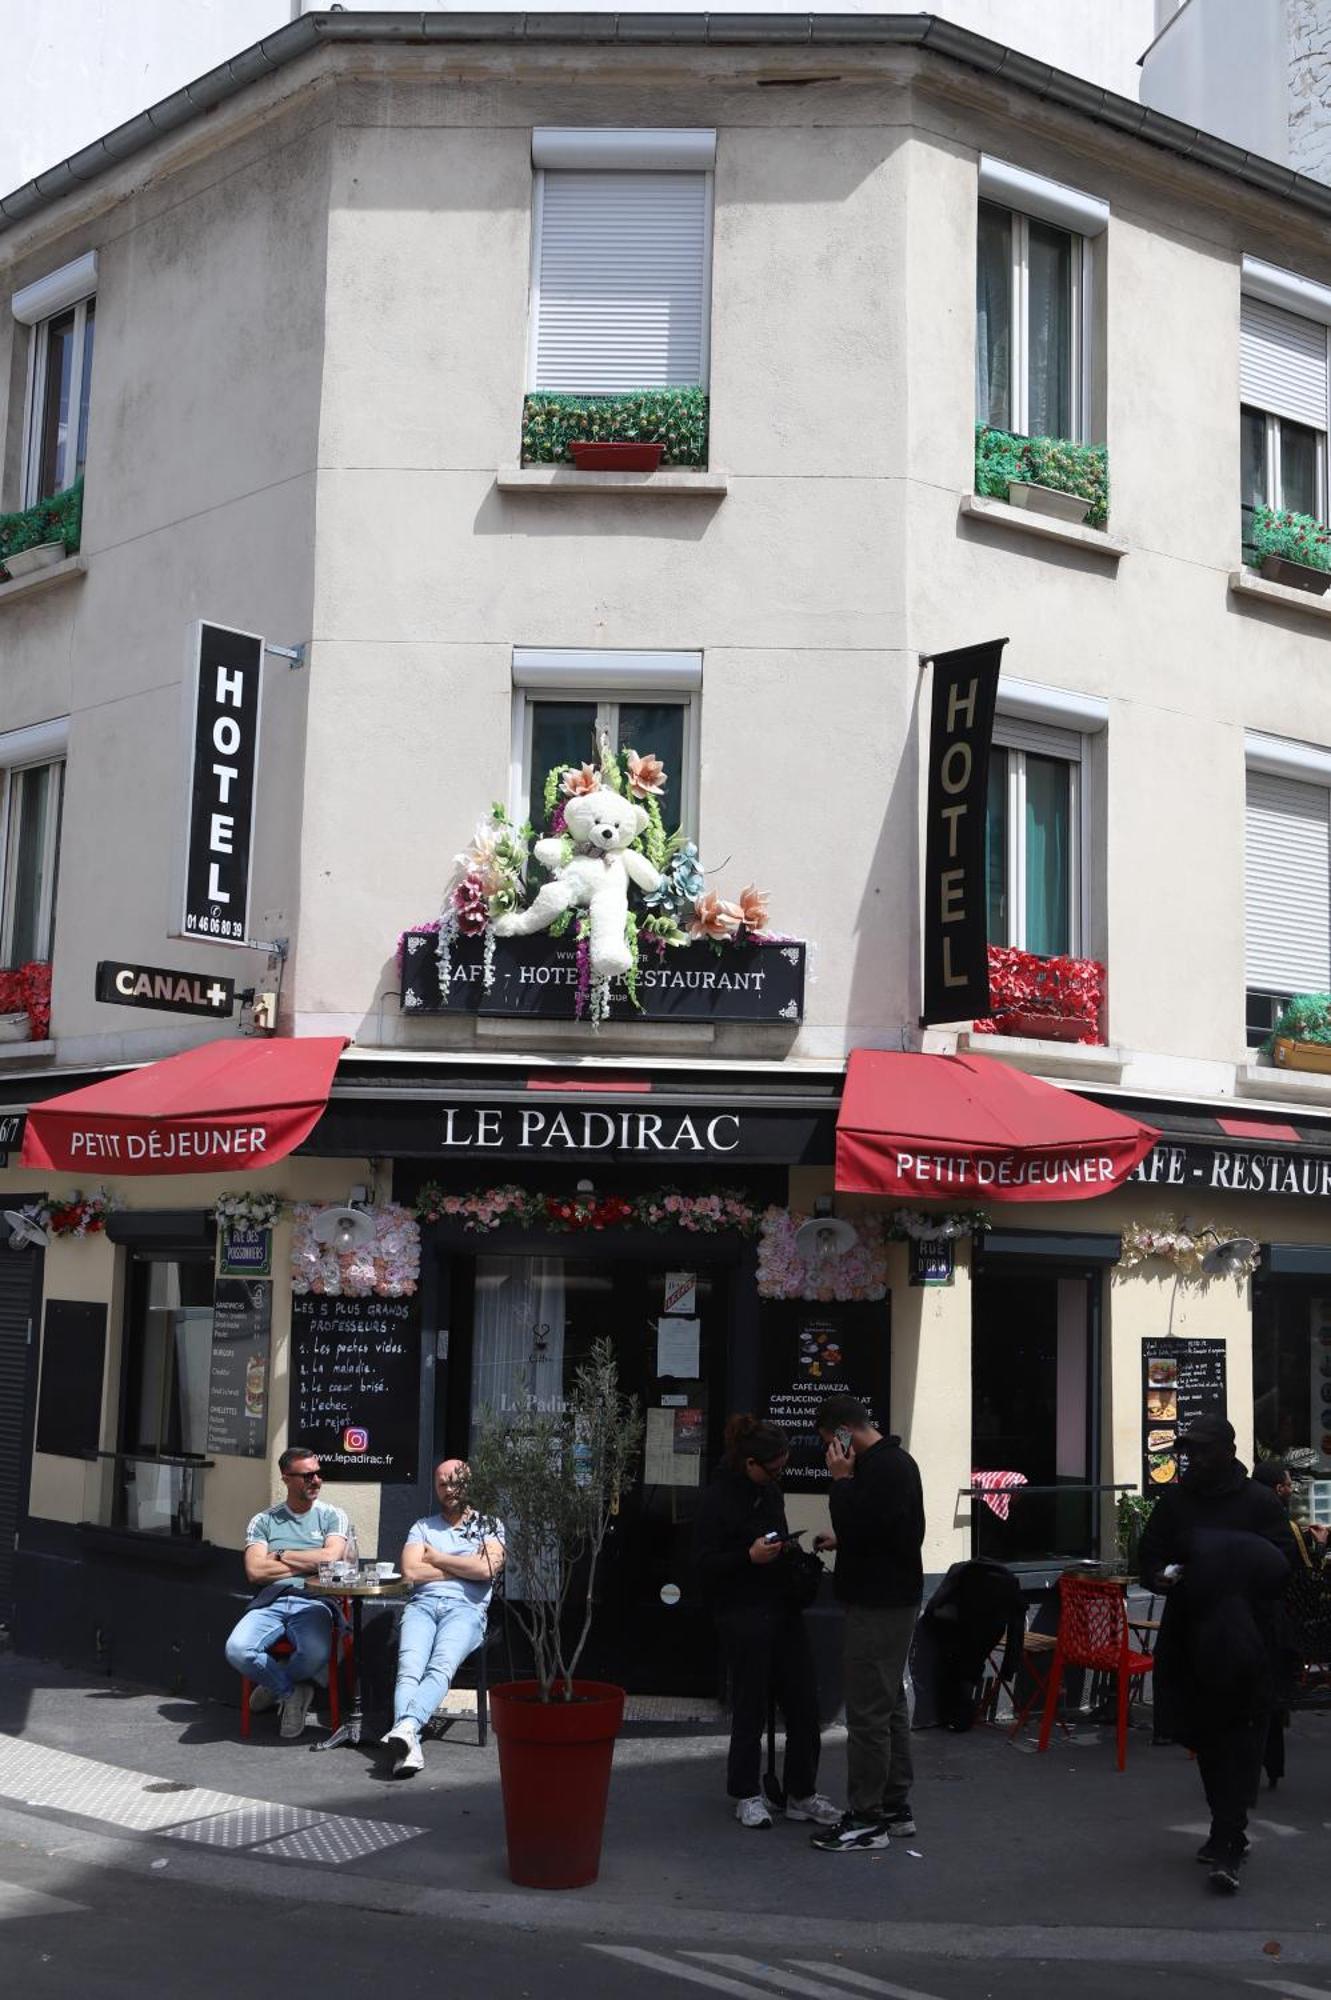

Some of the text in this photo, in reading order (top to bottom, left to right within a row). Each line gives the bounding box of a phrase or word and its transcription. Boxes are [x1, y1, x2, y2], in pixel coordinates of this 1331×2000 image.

[208, 666, 243, 903] HOTEL
[941, 677, 978, 988] HOTEL
[187, 914, 242, 937] 01 46 06 80 39
[519, 966, 593, 985] HOTE
[116, 970, 226, 1006] CANAL+
[442, 1108, 741, 1151] LE PADIRAC
[71, 1127, 267, 1159] PETIT DÉJEUNER
[896, 1153, 1115, 1184] PETIT DÉJEUNER
[1127, 1146, 1187, 1184] AFE
[920, 1240, 945, 1255] RUE
[294, 1302, 314, 1314] LES
[336, 1302, 360, 1316] PLUS
[367, 1303, 410, 1319] GRANDS
[311, 1320, 387, 1333] PROFESSEURS
[314, 1336, 331, 1355] Les
[313, 1357, 324, 1373] La
[312, 1375, 322, 1392] Le
[814, 1383, 850, 1392] LAVAZZA
[770, 1395, 823, 1404] CAPPUCCINO
[312, 1453, 394, 1465] ww.lepadirac.fr
